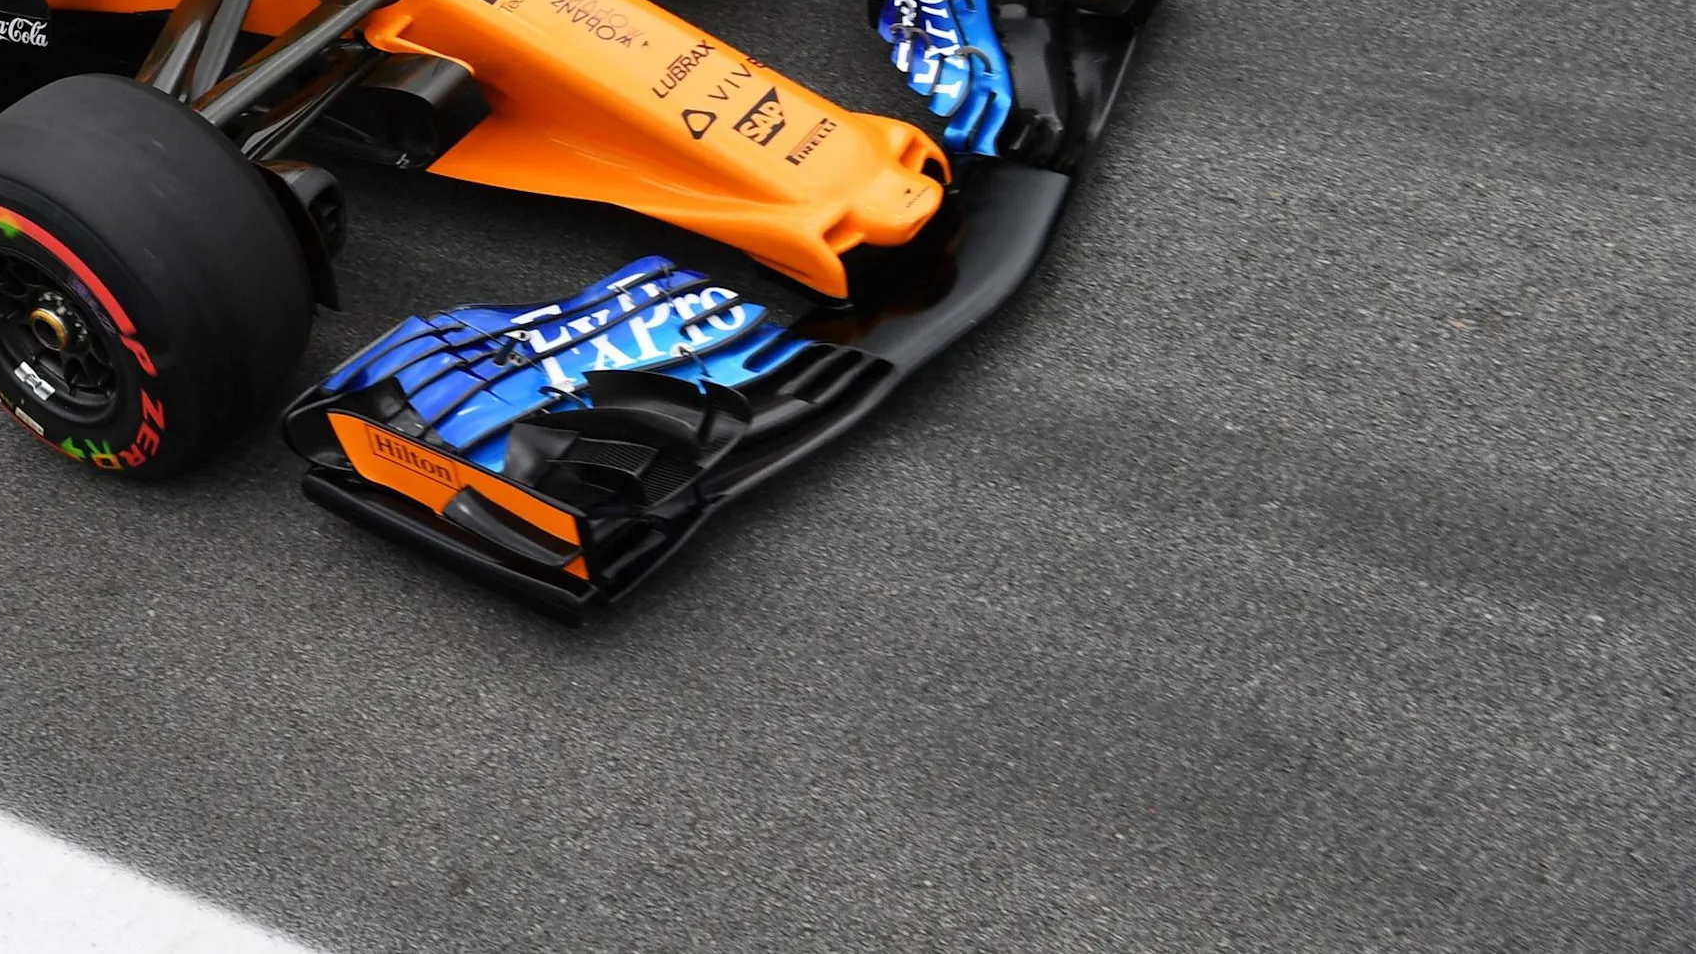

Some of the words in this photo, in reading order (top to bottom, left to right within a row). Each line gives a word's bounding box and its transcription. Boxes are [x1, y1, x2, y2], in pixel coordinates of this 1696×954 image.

[652, 39, 716, 99] LUBRAX
[735, 99, 787, 145] SAP
[784, 117, 837, 166] PIRELLI
[374, 432, 453, 482] Hilton
